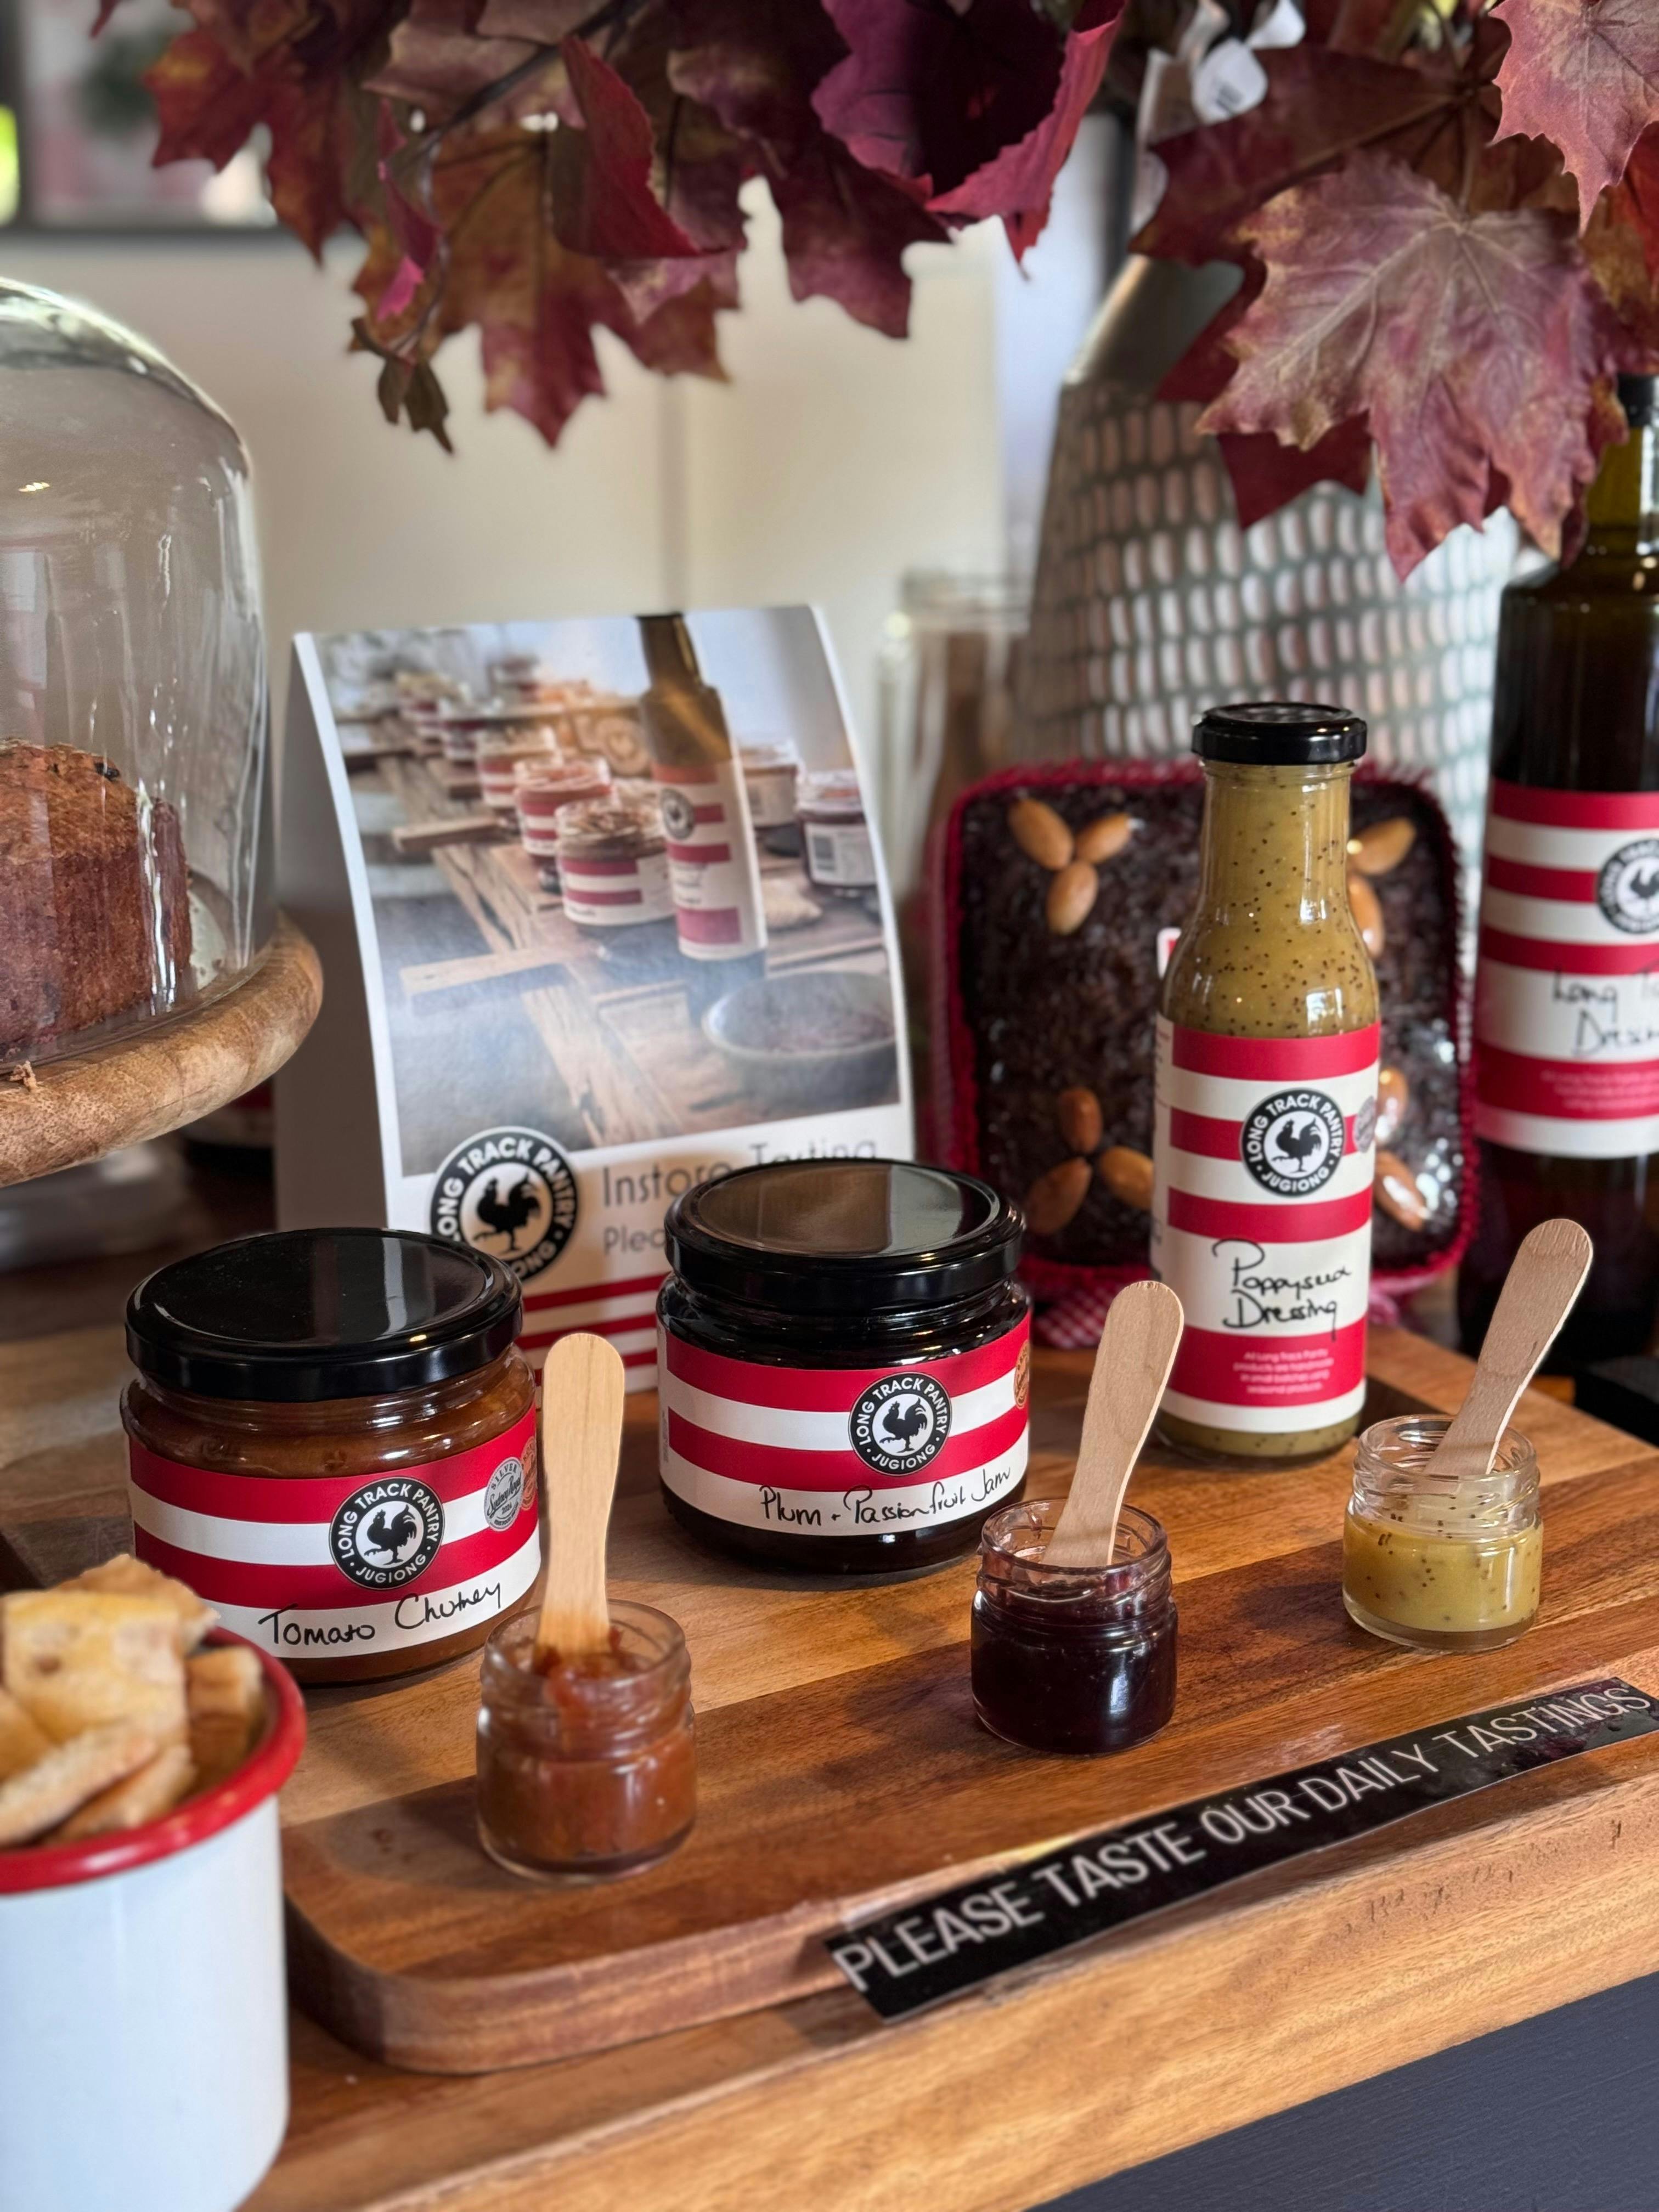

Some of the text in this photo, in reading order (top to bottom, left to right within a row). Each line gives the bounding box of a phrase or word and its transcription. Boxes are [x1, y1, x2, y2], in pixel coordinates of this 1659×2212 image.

[1246, 1115, 1268, 1163] LONG
[1265, 1094, 1321, 1116] TRACK
[1319, 1102, 1343, 1158] PANTRY
[437, 1136, 575, 1242] ONG TRACK PANTRY
[1261, 1166, 1330, 1193] JUGIONG
[1222, 1289, 1337, 1342] Dressing
[856, 1377, 948, 1446] LONG TRACK PANTRY
[491, 1462, 517, 1490] SILVER
[871, 1444, 935, 1470] JUGIONG
[338, 1511, 358, 1559] LONG
[354, 1483, 412, 1509] TRACK
[412, 1488, 439, 1542] PANTRY
[759, 1485, 822, 1527] Plum
[970, 1468, 1011, 1502] Jam
[356, 1554, 426, 1583] JUGIONG
[258, 1602, 376, 1645] Tomato
[832, 1686, 1651, 1992] PLEASE TASTE OUR DAILY TASTINGS
